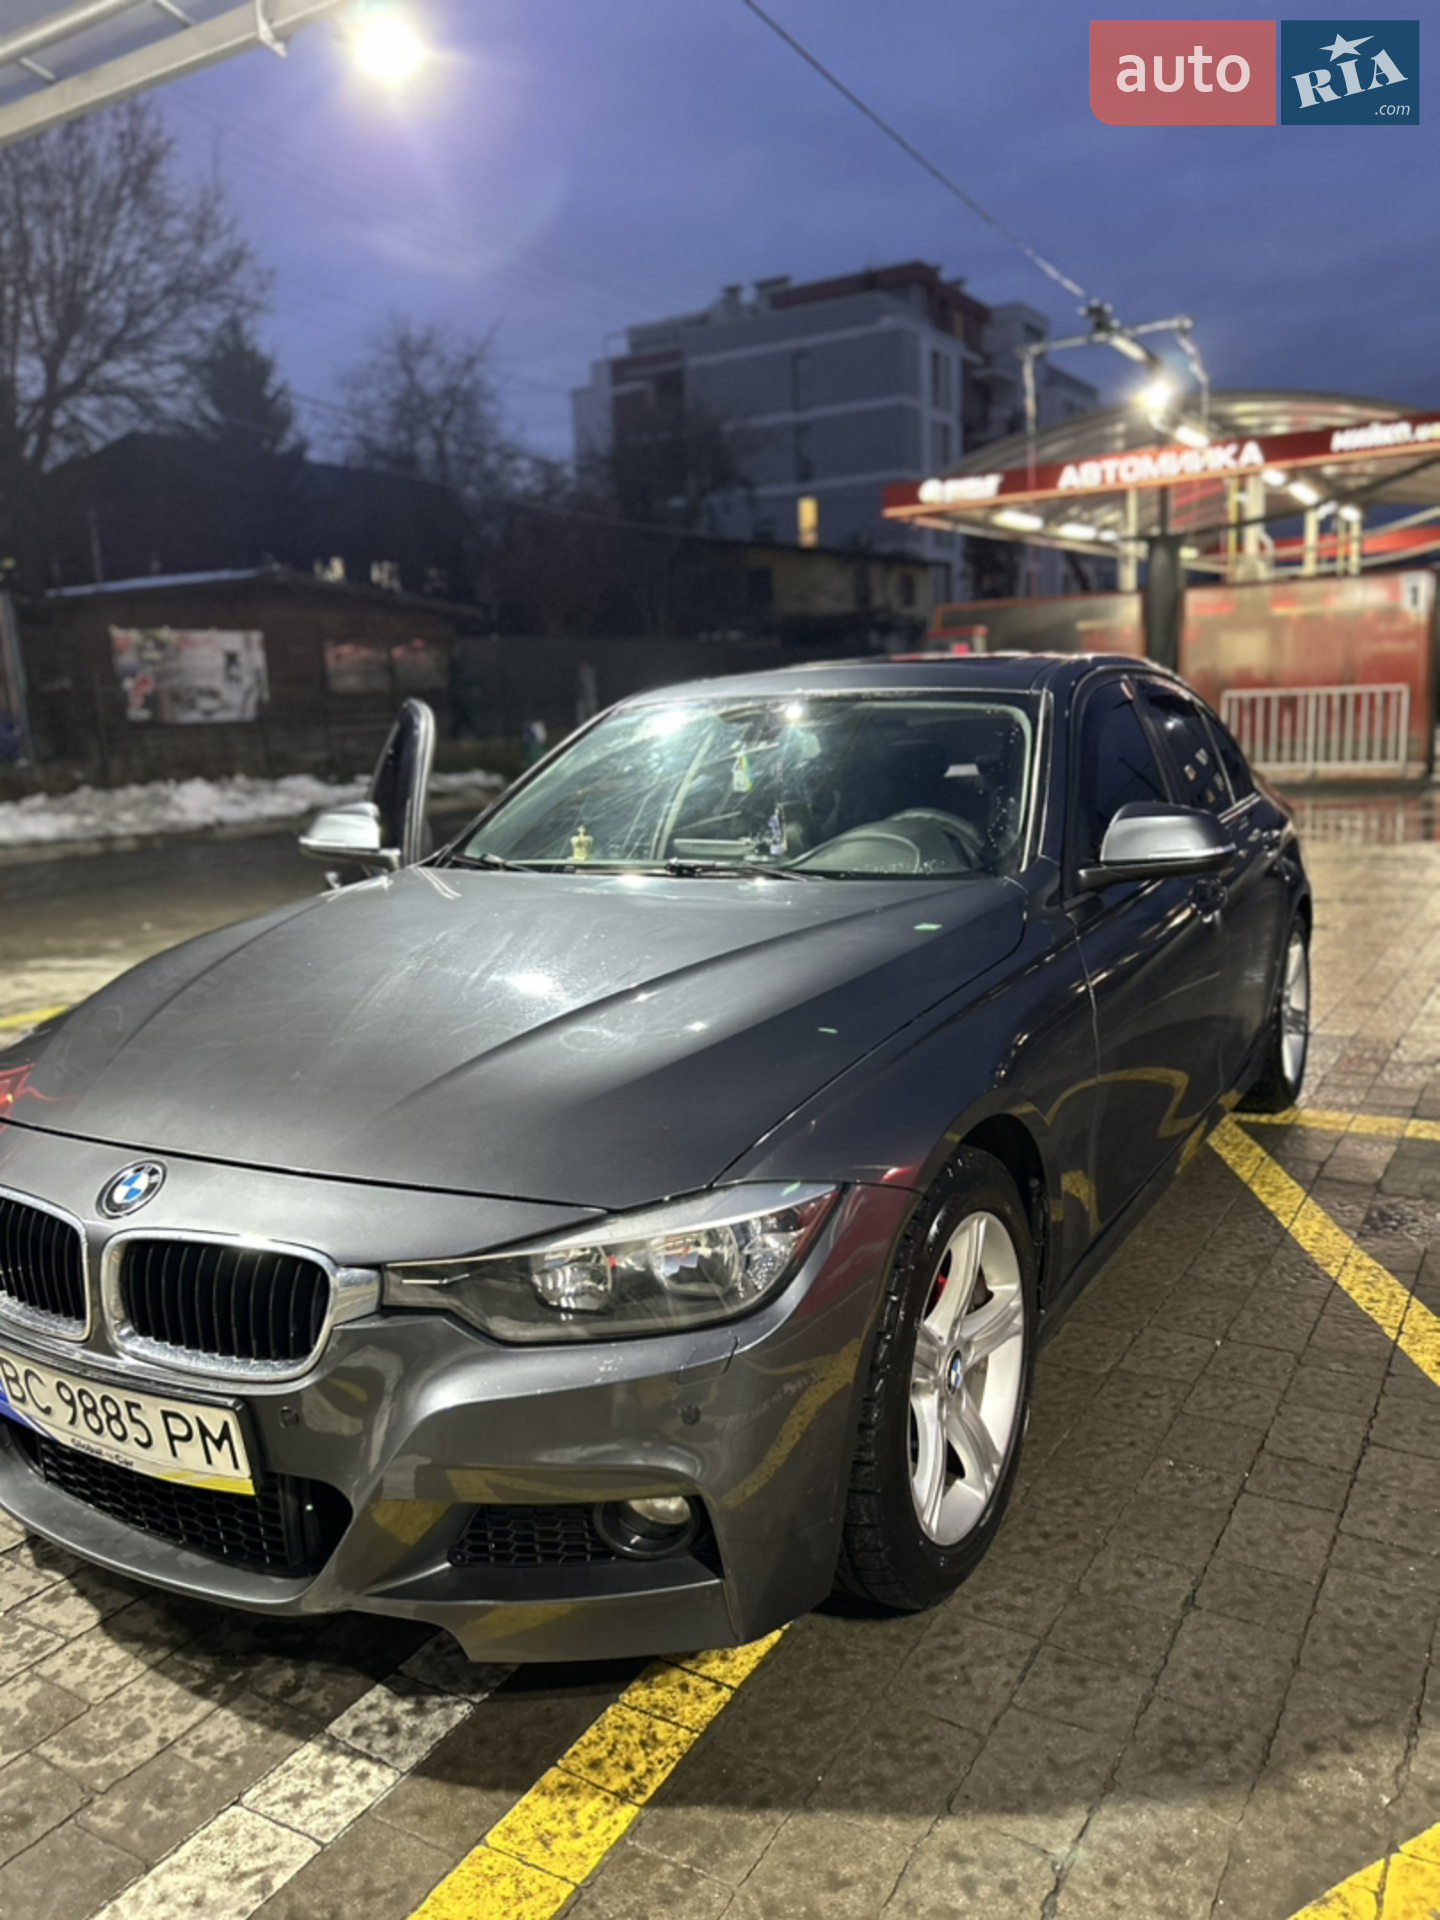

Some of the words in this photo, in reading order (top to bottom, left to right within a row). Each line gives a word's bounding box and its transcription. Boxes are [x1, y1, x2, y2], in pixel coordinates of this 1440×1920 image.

[1057, 441, 1265, 491] АВТОМИЙКА
[0, 1356, 53, 1416] BC
[56, 1380, 154, 1450] 9885
[160, 1408, 240, 1471] PM
